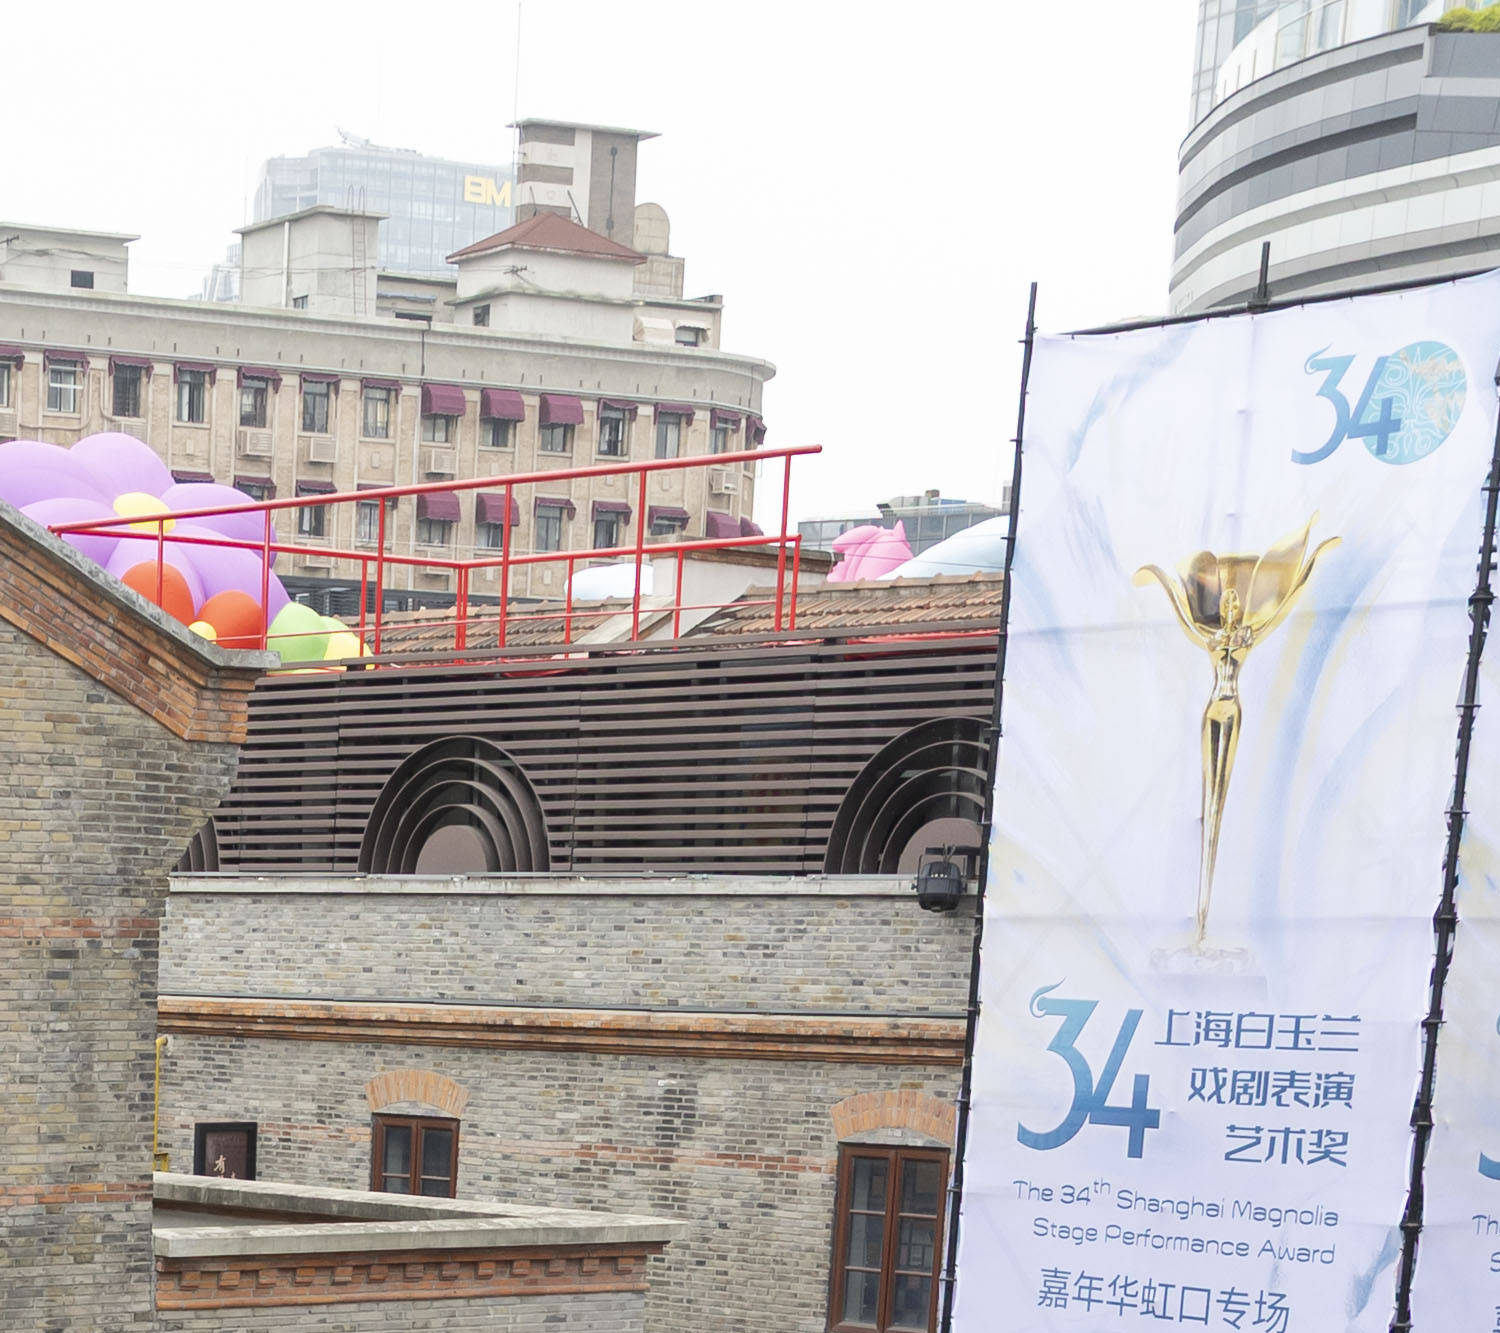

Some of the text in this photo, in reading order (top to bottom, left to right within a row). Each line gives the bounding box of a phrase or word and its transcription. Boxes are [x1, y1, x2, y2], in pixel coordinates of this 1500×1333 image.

[1154, 1009, 1361, 1052] 上海白玉兰
[1017, 977, 1160, 1159] 34
[1188, 1066, 1355, 1110] 戏剧表演
[1224, 1125, 1349, 1168] 艺术奖
[1013, 1180, 1053, 1202] The
[1116, 1188, 1225, 1220] Shanghai
[1232, 1200, 1339, 1228] Magnolia
[1033, 1217, 1336, 1265] Stage Performance Award
